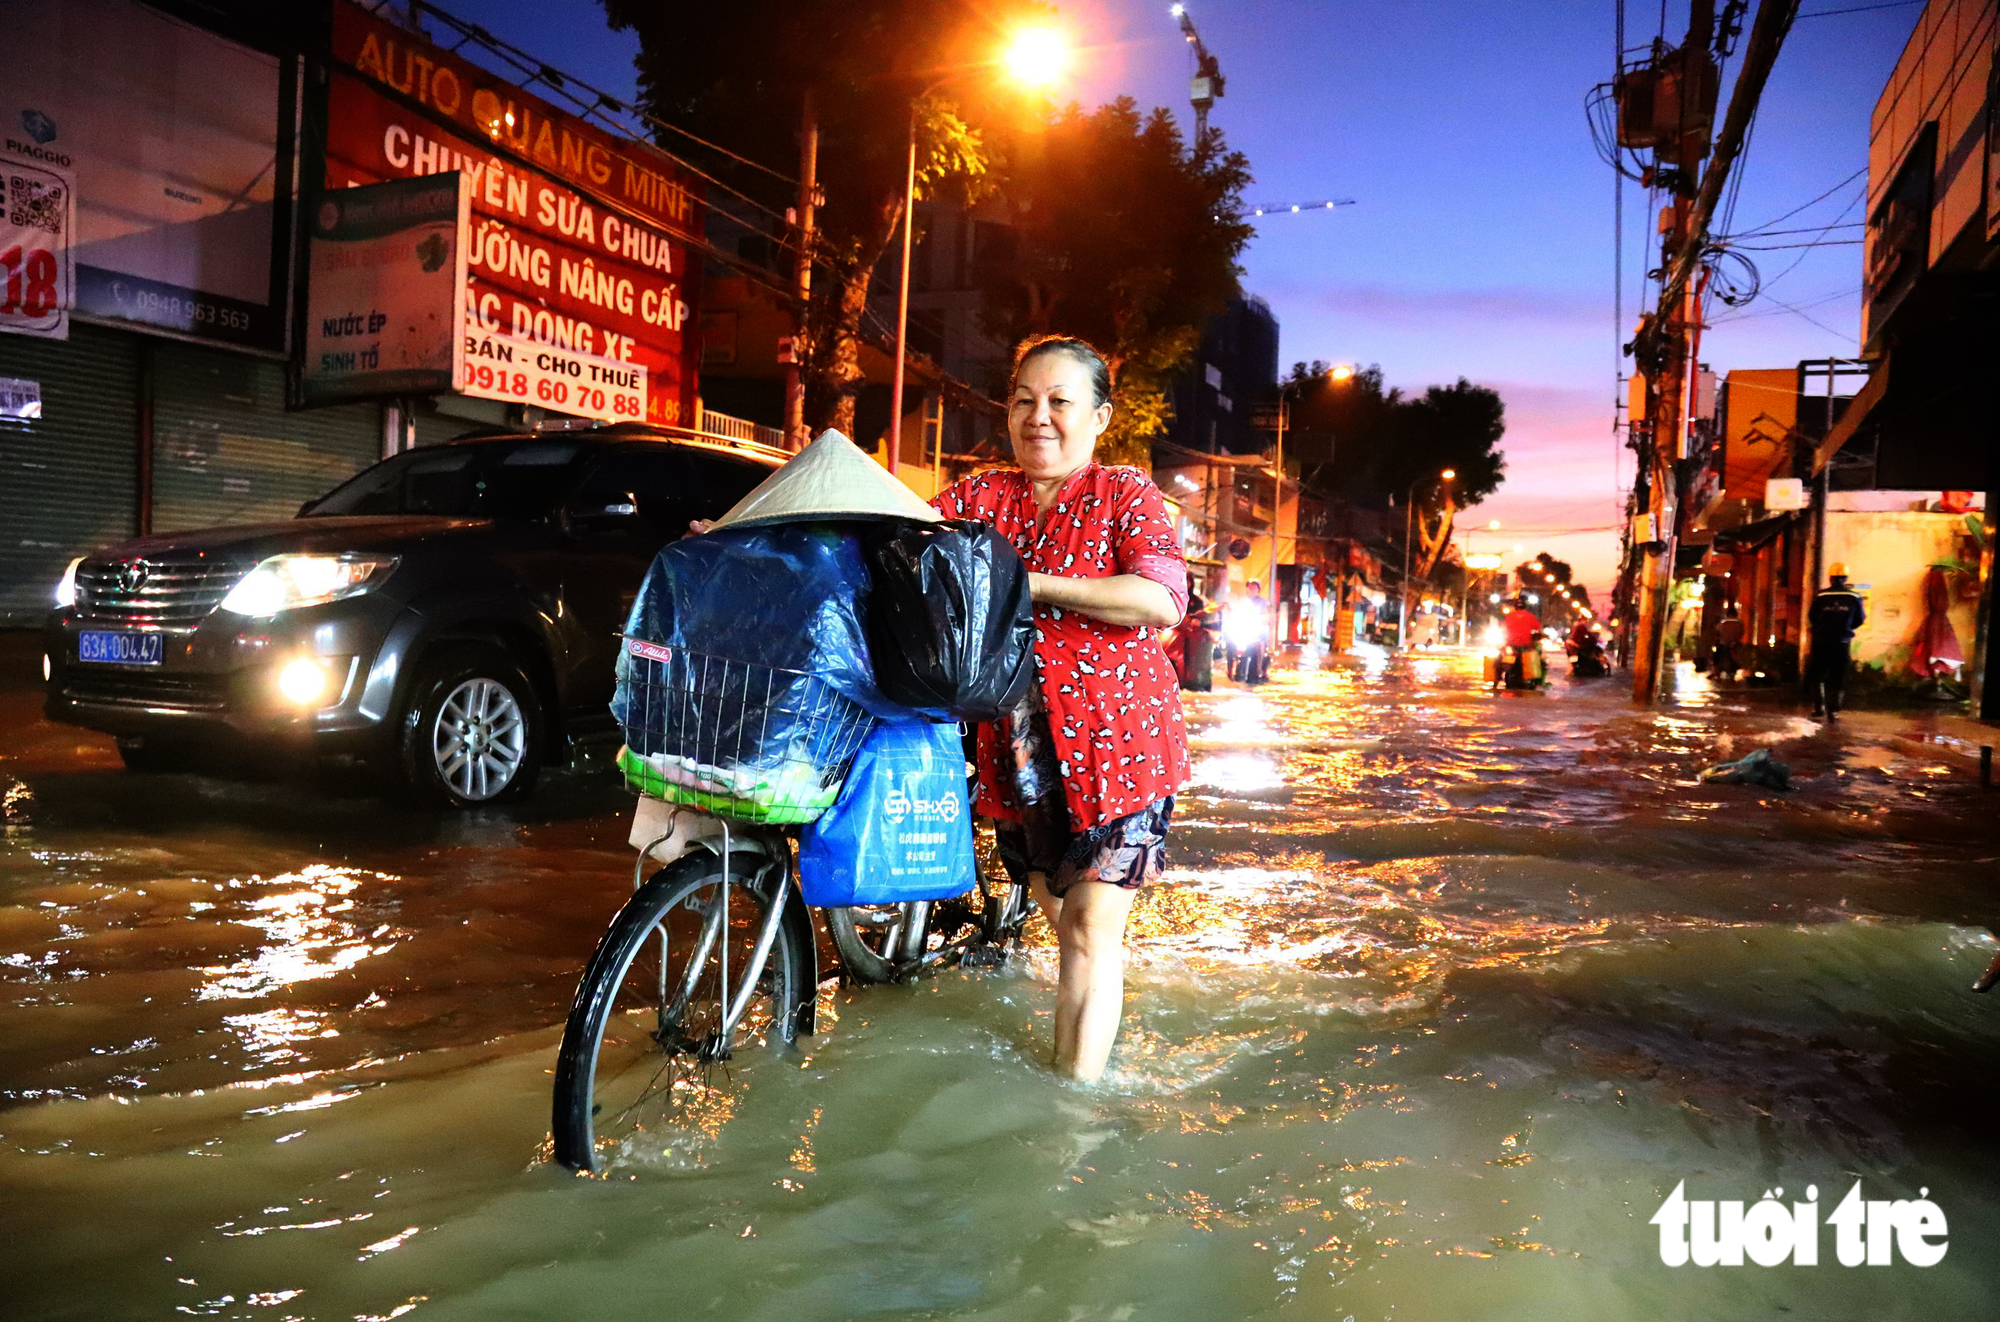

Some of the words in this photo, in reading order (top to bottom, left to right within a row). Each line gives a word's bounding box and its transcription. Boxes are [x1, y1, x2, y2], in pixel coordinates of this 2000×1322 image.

[357, 32, 461, 117] AUTO
[471, 87, 613, 185] QUANG
[624, 157, 695, 225] MINH
[6, 139, 71, 167] PIAGGIO
[468, 218, 551, 289] ƯỠNG
[560, 257, 634, 316] NÂNG
[641, 283, 690, 332] CẤP
[185, 302, 216, 325] 963
[220, 309, 250, 330] 563
[369, 309, 387, 333] ÉP
[466, 276, 502, 333] ÁC
[511, 297, 593, 355] DÒNG
[603, 330, 636, 363] XE
[322, 351, 356, 372] SINH
[360, 341, 381, 370] TỐ
[465, 336, 513, 363] BÁN
[537, 353, 581, 378] CHO
[588, 365, 640, 390] THUÊ
[465, 362, 528, 396] 0918
[537, 378, 568, 404] 60
[577, 385, 605, 411] 70
[613, 393, 641, 417] 88
[647, 395, 690, 423] 4.899
